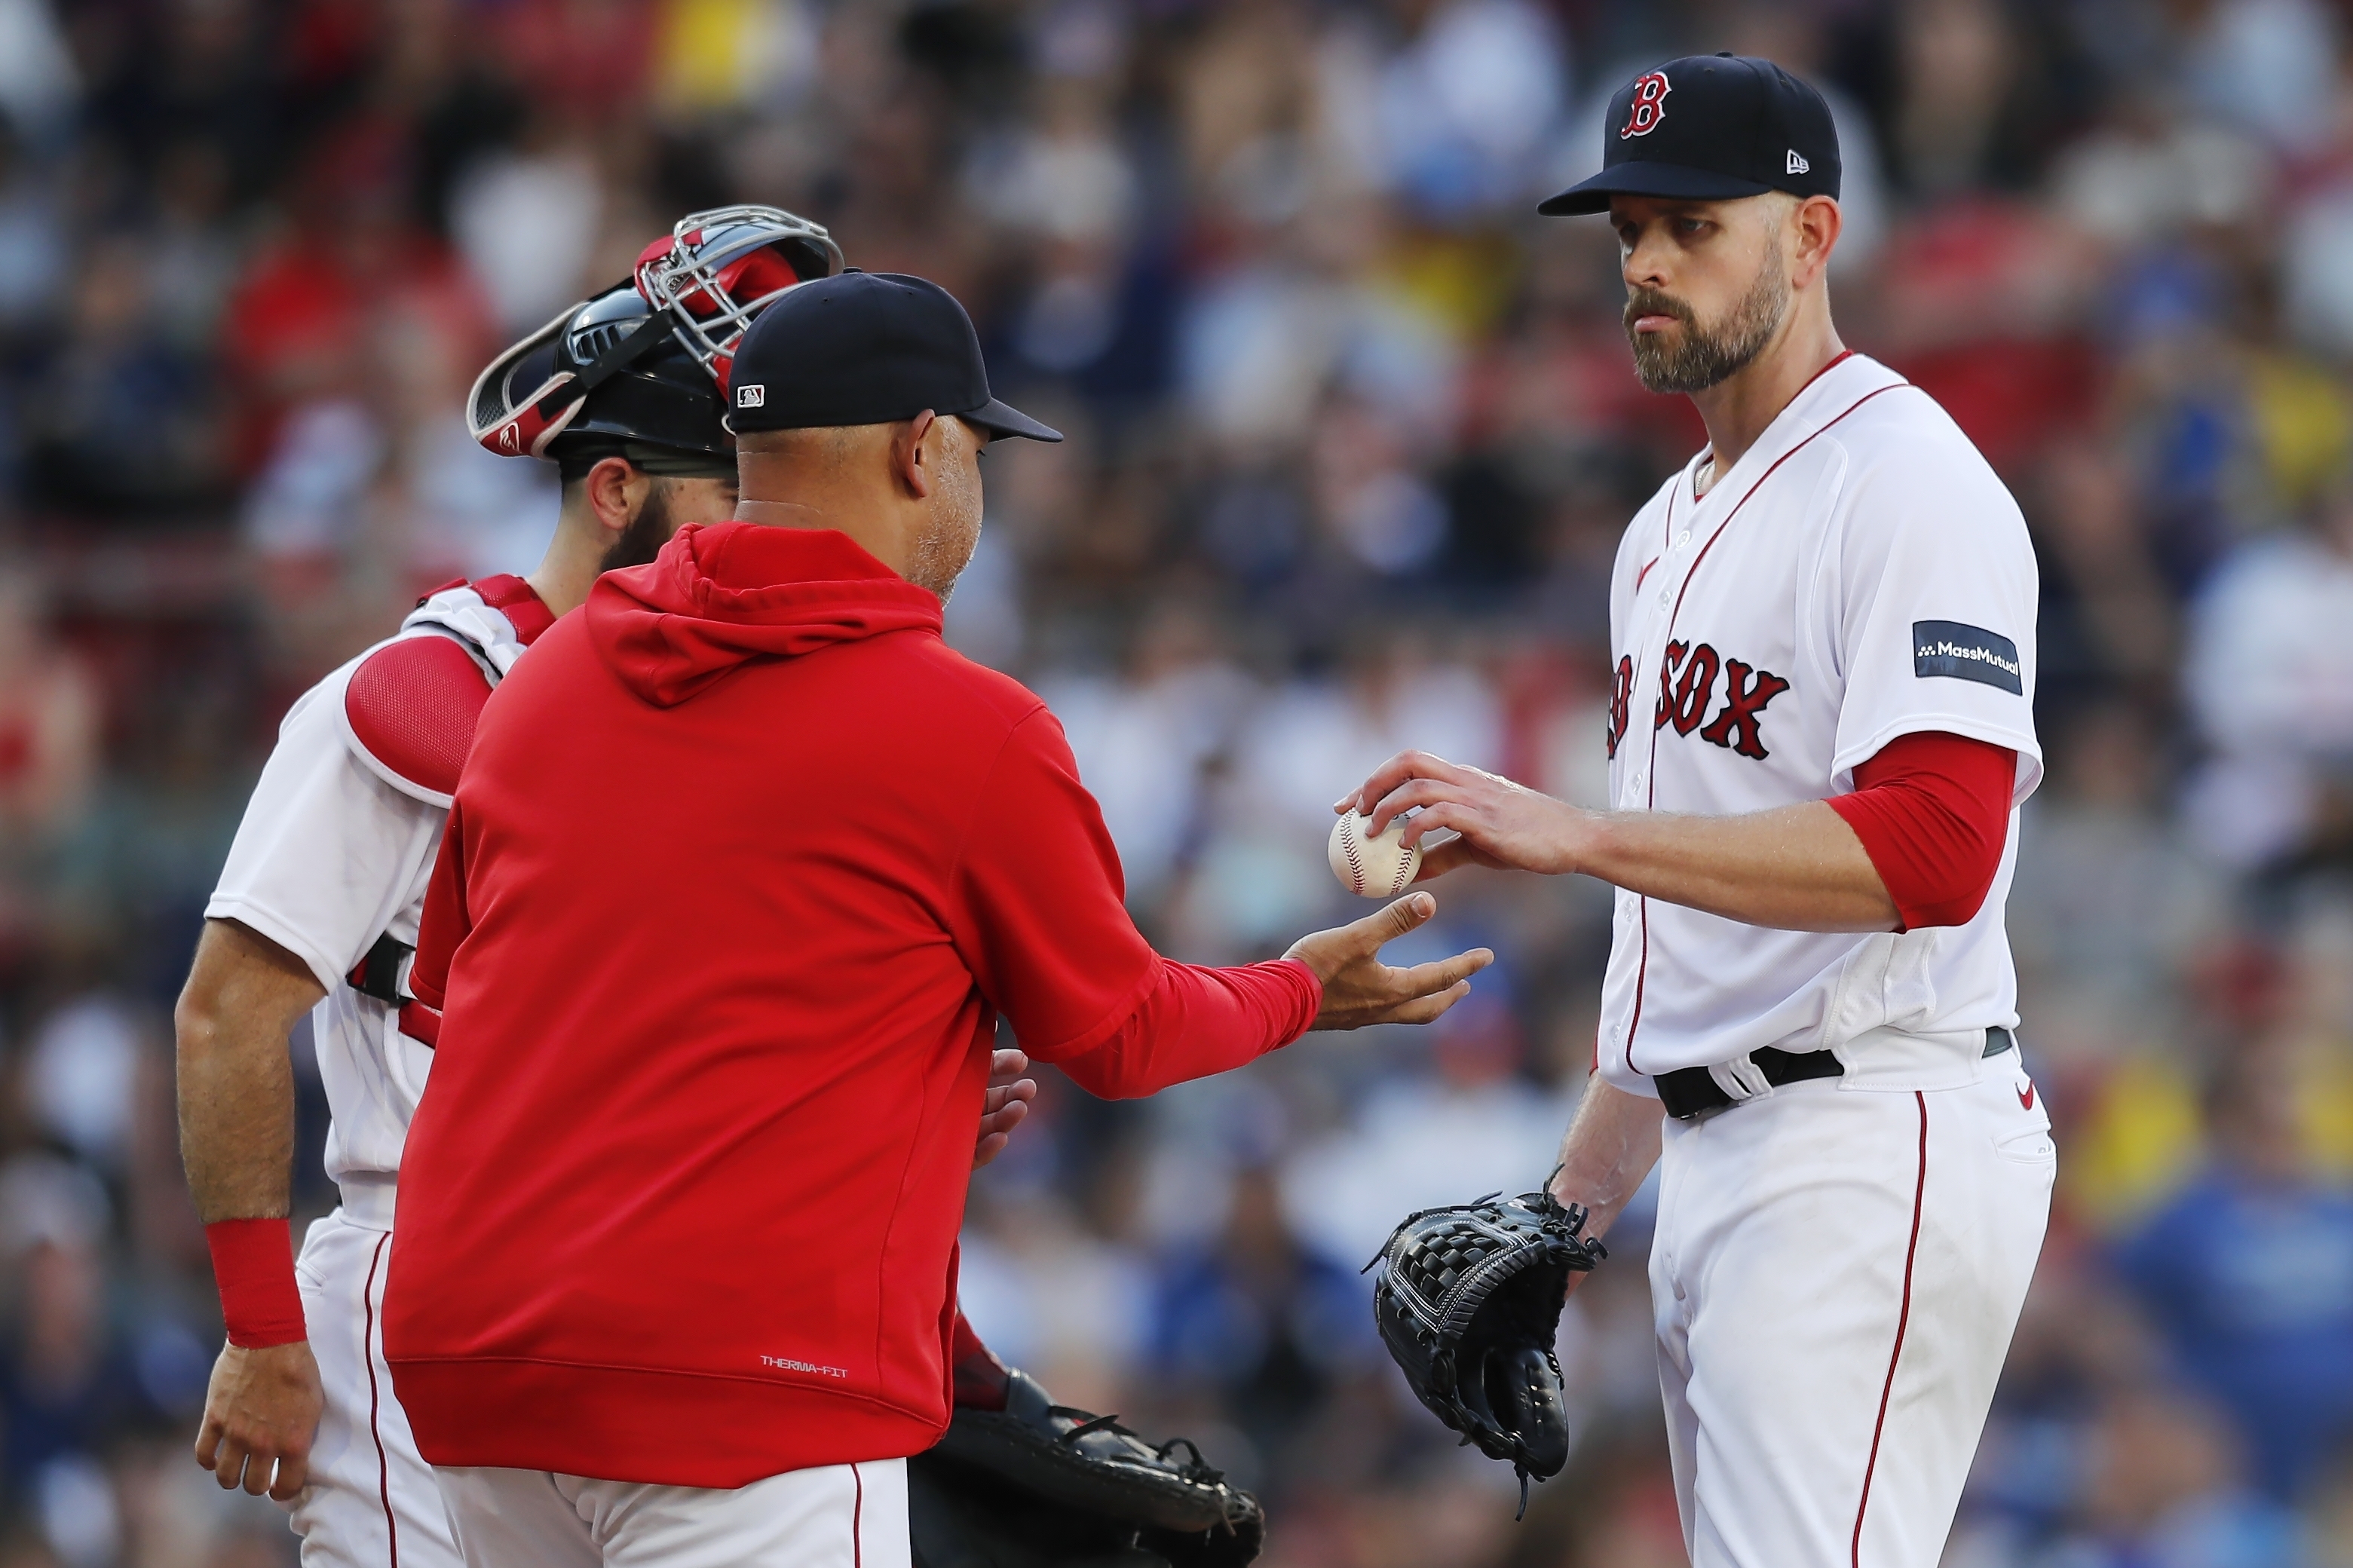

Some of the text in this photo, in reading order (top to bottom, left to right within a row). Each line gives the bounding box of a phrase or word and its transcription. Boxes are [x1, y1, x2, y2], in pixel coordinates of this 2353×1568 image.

[1620, 72, 1672, 139] B
[1937, 641, 2018, 676] MassMutual
[760, 1355, 847, 1378] THERMA-FIT
